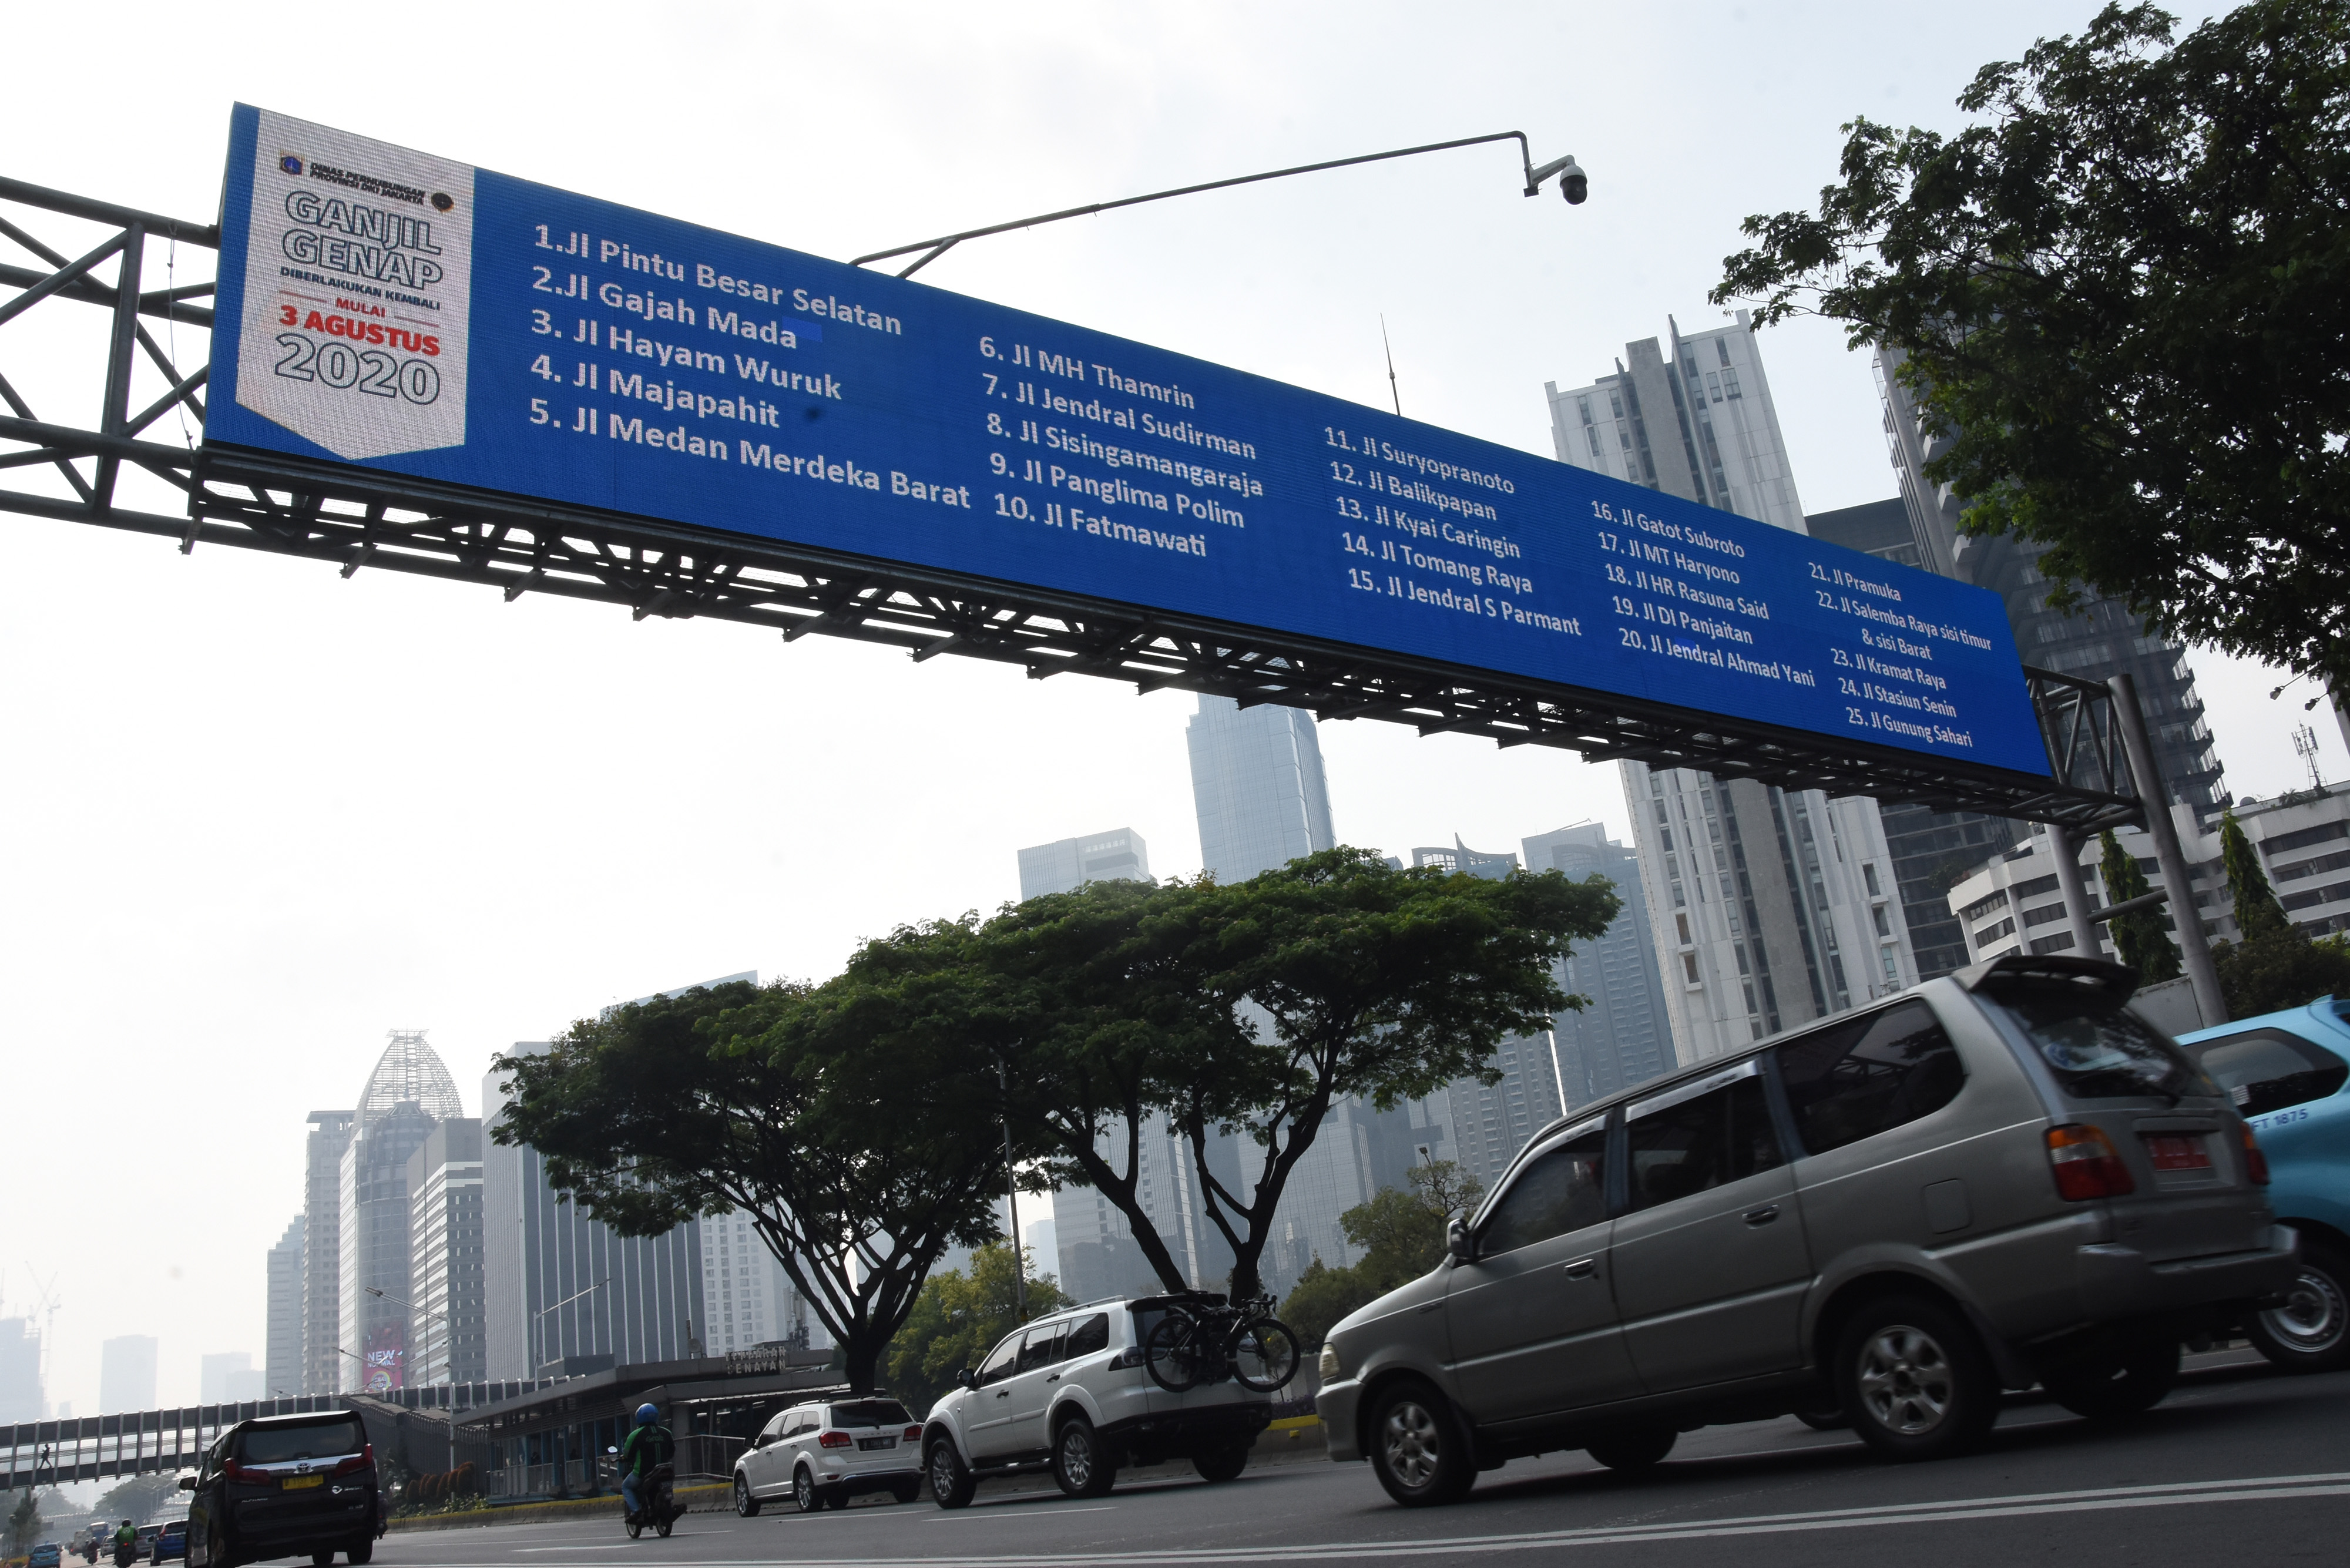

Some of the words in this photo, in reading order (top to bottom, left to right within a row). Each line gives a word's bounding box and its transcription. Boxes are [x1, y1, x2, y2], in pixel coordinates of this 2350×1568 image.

[310, 162, 344, 176] DINAS
[346, 172, 426, 197] PERHUBUNGAN
[310, 170, 359, 189] PROVINSI
[360, 183, 381, 194] DKI
[381, 189, 424, 205] JAKARTA
[286, 190, 441, 256] GANJIL
[280, 266, 381, 297] DIBERLAKUKAN
[385, 290, 441, 311] KEMBALI
[283, 229, 443, 290] GENAP
[535, 224, 588, 258] 1.Jl
[600, 239, 684, 281] Pintu
[697, 263, 783, 305] Besar
[793, 288, 901, 335] Selatan
[280, 305, 298, 326] 3
[304, 311, 440, 357] AGUSTUS
[336, 297, 386, 317] MULAI
[532, 266, 588, 300] 2.Jl
[599, 283, 695, 325] Gajah
[708, 307, 796, 349] Mada
[274, 333, 440, 405] 2020
[532, 308, 562, 338] 3.
[610, 325, 725, 374] Hayam
[734, 354, 842, 399] Wuruk
[979, 336, 1003, 361] 6.
[1038, 350, 1084, 381] MH
[1092, 364, 1194, 409] Thamrin
[531, 354, 561, 383] 4.
[610, 369, 779, 428] Majapahit
[982, 372, 1007, 399] 7.
[1042, 388, 1136, 429] Jendral
[1142, 413, 1255, 459] Sudirman
[530, 398, 560, 428] 5.
[610, 413, 727, 461] Medan
[740, 440, 879, 491] Merdeka
[891, 471, 971, 509] Barat
[987, 413, 1010, 438] 8.
[1045, 426, 1263, 498] Sisingamangaraja
[1325, 427, 1357, 452] 11.
[1381, 442, 1515, 493] Suryopranoto
[990, 452, 1015, 478] 9.
[1050, 465, 1168, 511] Panglima
[1176, 493, 1244, 528] Polim
[1331, 461, 1362, 486] 12.
[1388, 475, 1496, 521] Balikpapan
[995, 493, 1035, 522] 10.
[1070, 508, 1206, 557] Fatmawati
[1336, 496, 1368, 521] 13.
[1394, 510, 1438, 538] Kyai
[1442, 523, 1520, 558] Caringin
[1592, 501, 1617, 523] 16.
[1637, 513, 1683, 540] Gatot
[1684, 526, 1745, 558] Subroto
[1342, 532, 1375, 557] 14.
[1399, 545, 1482, 586] Tomang
[1486, 565, 1533, 595] Raya
[1597, 531, 1625, 555] 17.
[1643, 543, 1670, 566] MT
[1674, 552, 1740, 584] Haryono
[1808, 562, 1831, 582] 21.
[1844, 572, 1902, 602] Pramuka
[1348, 568, 1381, 593] 15.
[1408, 580, 1481, 615] Jendral
[1485, 598, 1496, 617] S
[1501, 601, 1582, 636] Parmant
[1605, 563, 1631, 586] 18.
[1650, 575, 1676, 596] HR
[1678, 582, 1735, 611] Rasuna
[1737, 597, 1769, 620] Said
[1613, 596, 1639, 617] 19.
[1657, 606, 1677, 626] DI
[1679, 612, 1753, 644] Panjaitan
[1815, 590, 1838, 610] 22.
[1852, 600, 1906, 627] Salemba
[1908, 615, 1938, 638] Raya
[1940, 624, 1959, 642] sisi
[1960, 630, 1991, 650] timur
[1619, 627, 1646, 650] 20.
[1666, 638, 1724, 667] Jendral
[1728, 652, 1780, 680] Ahmad
[1781, 664, 1815, 687] Yani
[1831, 648, 1853, 667] 23.
[1867, 657, 1915, 681] Kramat
[1915, 668, 1946, 691] Raya
[1862, 628, 1874, 646] &
[1876, 632, 1897, 652] sisi
[1897, 638, 1932, 660] Barat
[1838, 677, 1861, 697] 24.
[1874, 685, 1921, 710] Stasiun
[1922, 696, 1957, 717] Senin
[1846, 706, 1869, 727] 25.
[1882, 714, 1933, 744] Gunung
[1933, 725, 1973, 748] Sahari
[2273, 1109, 2309, 1126] 1875
[367, 1349, 395, 1362] NEW
[727, 1359, 786, 1375] SENAYAN
